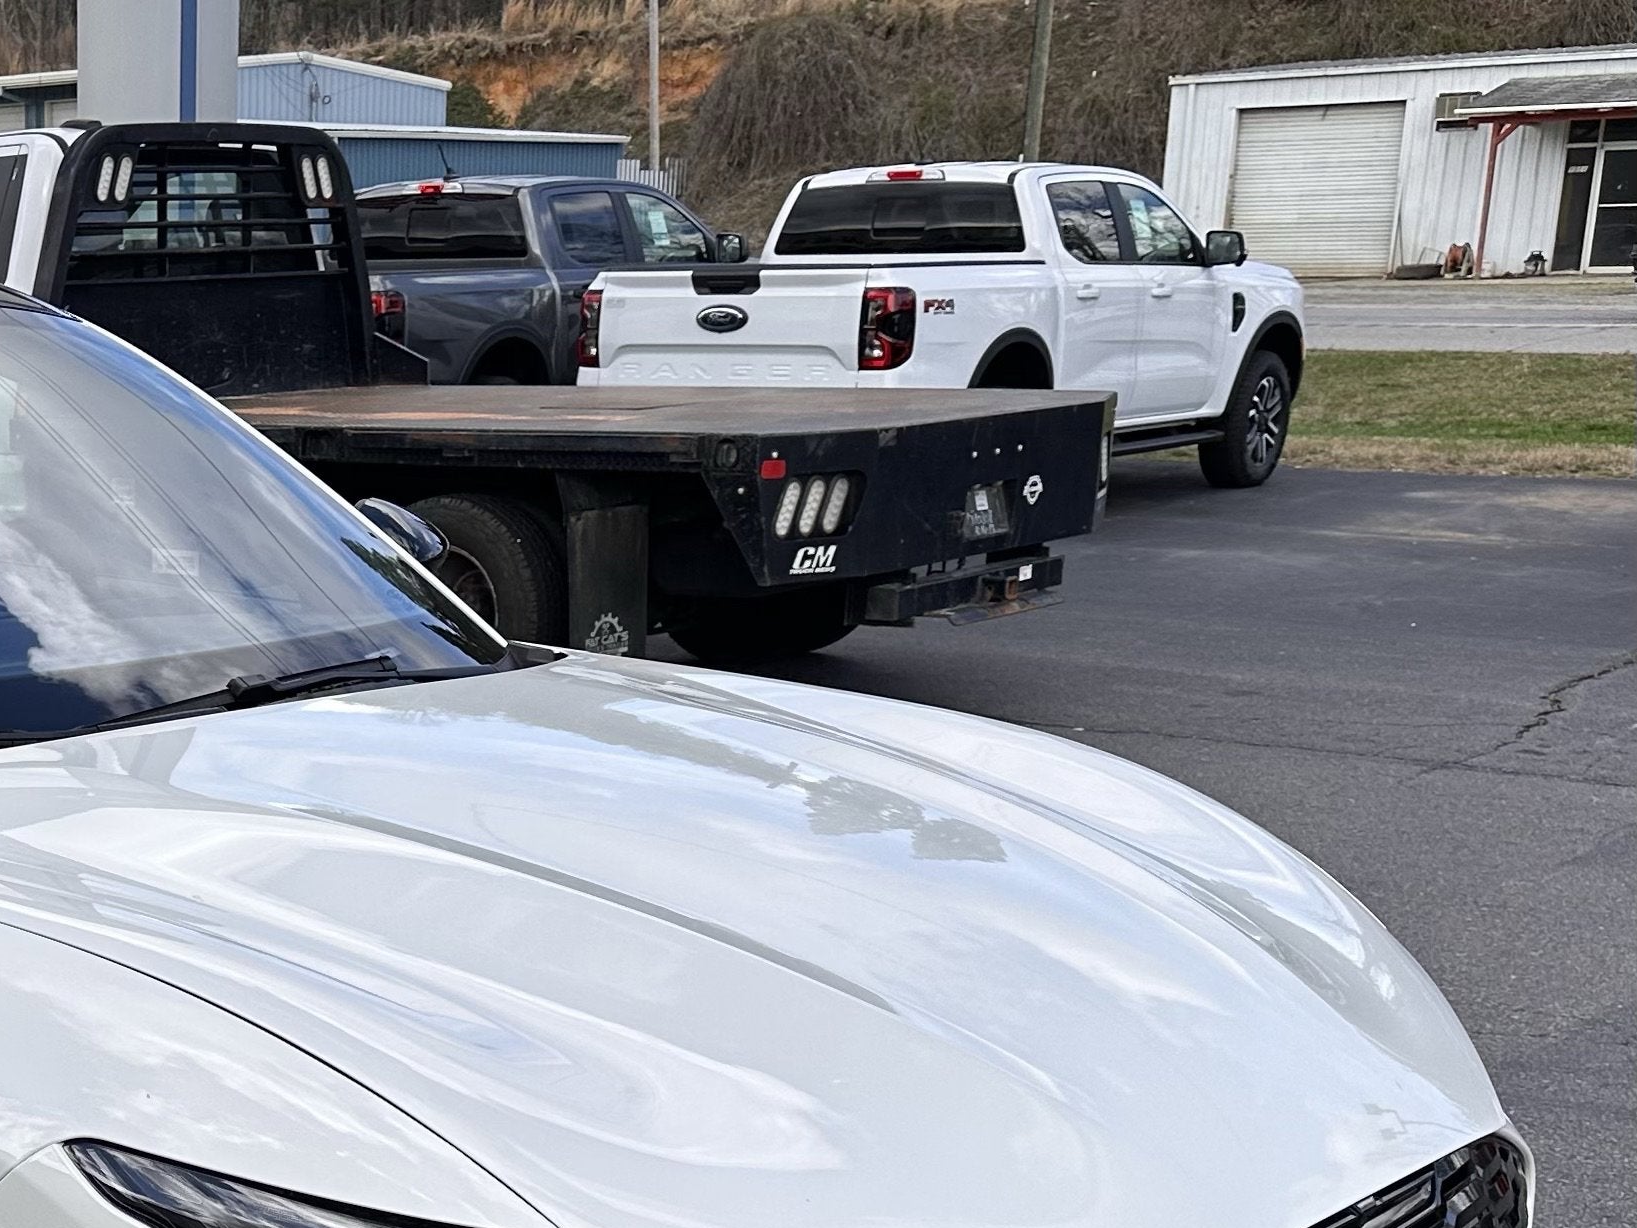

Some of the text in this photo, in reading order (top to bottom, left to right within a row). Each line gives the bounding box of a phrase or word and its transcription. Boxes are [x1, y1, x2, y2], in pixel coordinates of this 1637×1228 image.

[924, 299, 955, 313] FX4
[619, 362, 831, 381] RANGER
[792, 545, 838, 569] CM
